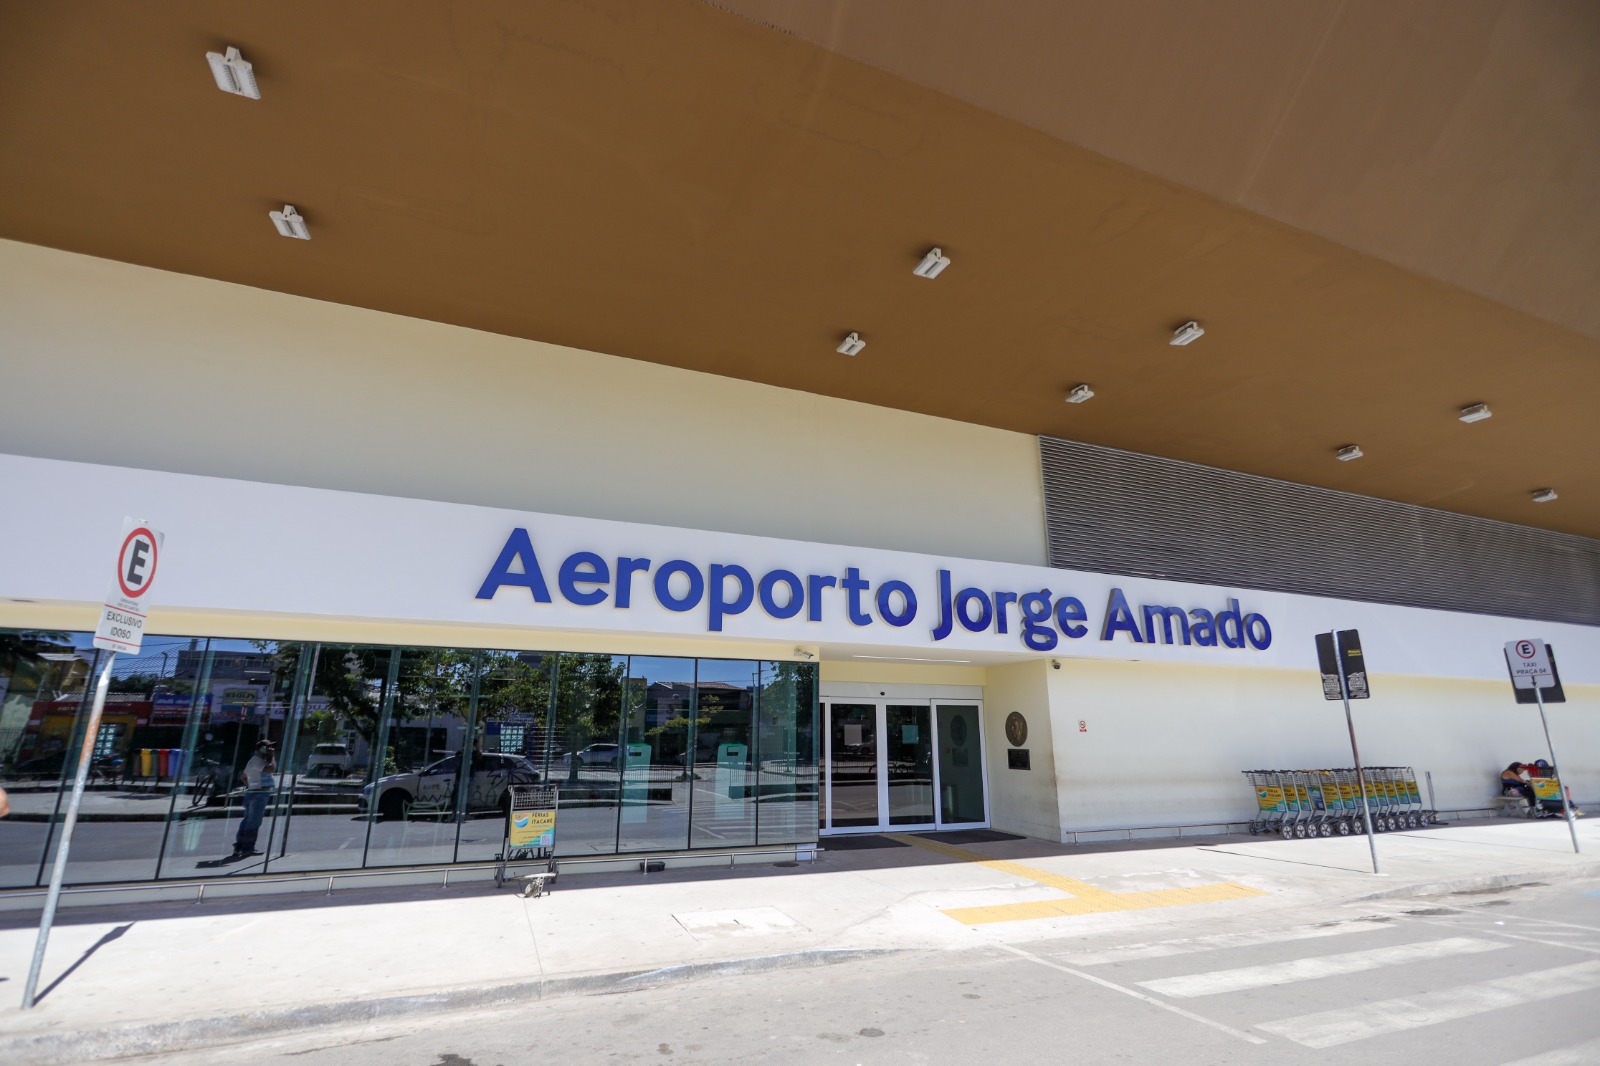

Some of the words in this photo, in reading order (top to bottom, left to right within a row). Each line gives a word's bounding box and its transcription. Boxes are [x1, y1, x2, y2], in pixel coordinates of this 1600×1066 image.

[127, 539, 149, 585] E
[474, 526, 918, 632] Aeroporto
[930, 569, 1089, 652] Jorge
[1099, 587, 1273, 651] Amado
[107, 611, 142, 628] EXCLUSIVO
[110, 626, 131, 639] IDOSO
[1521, 644, 1531, 654] E
